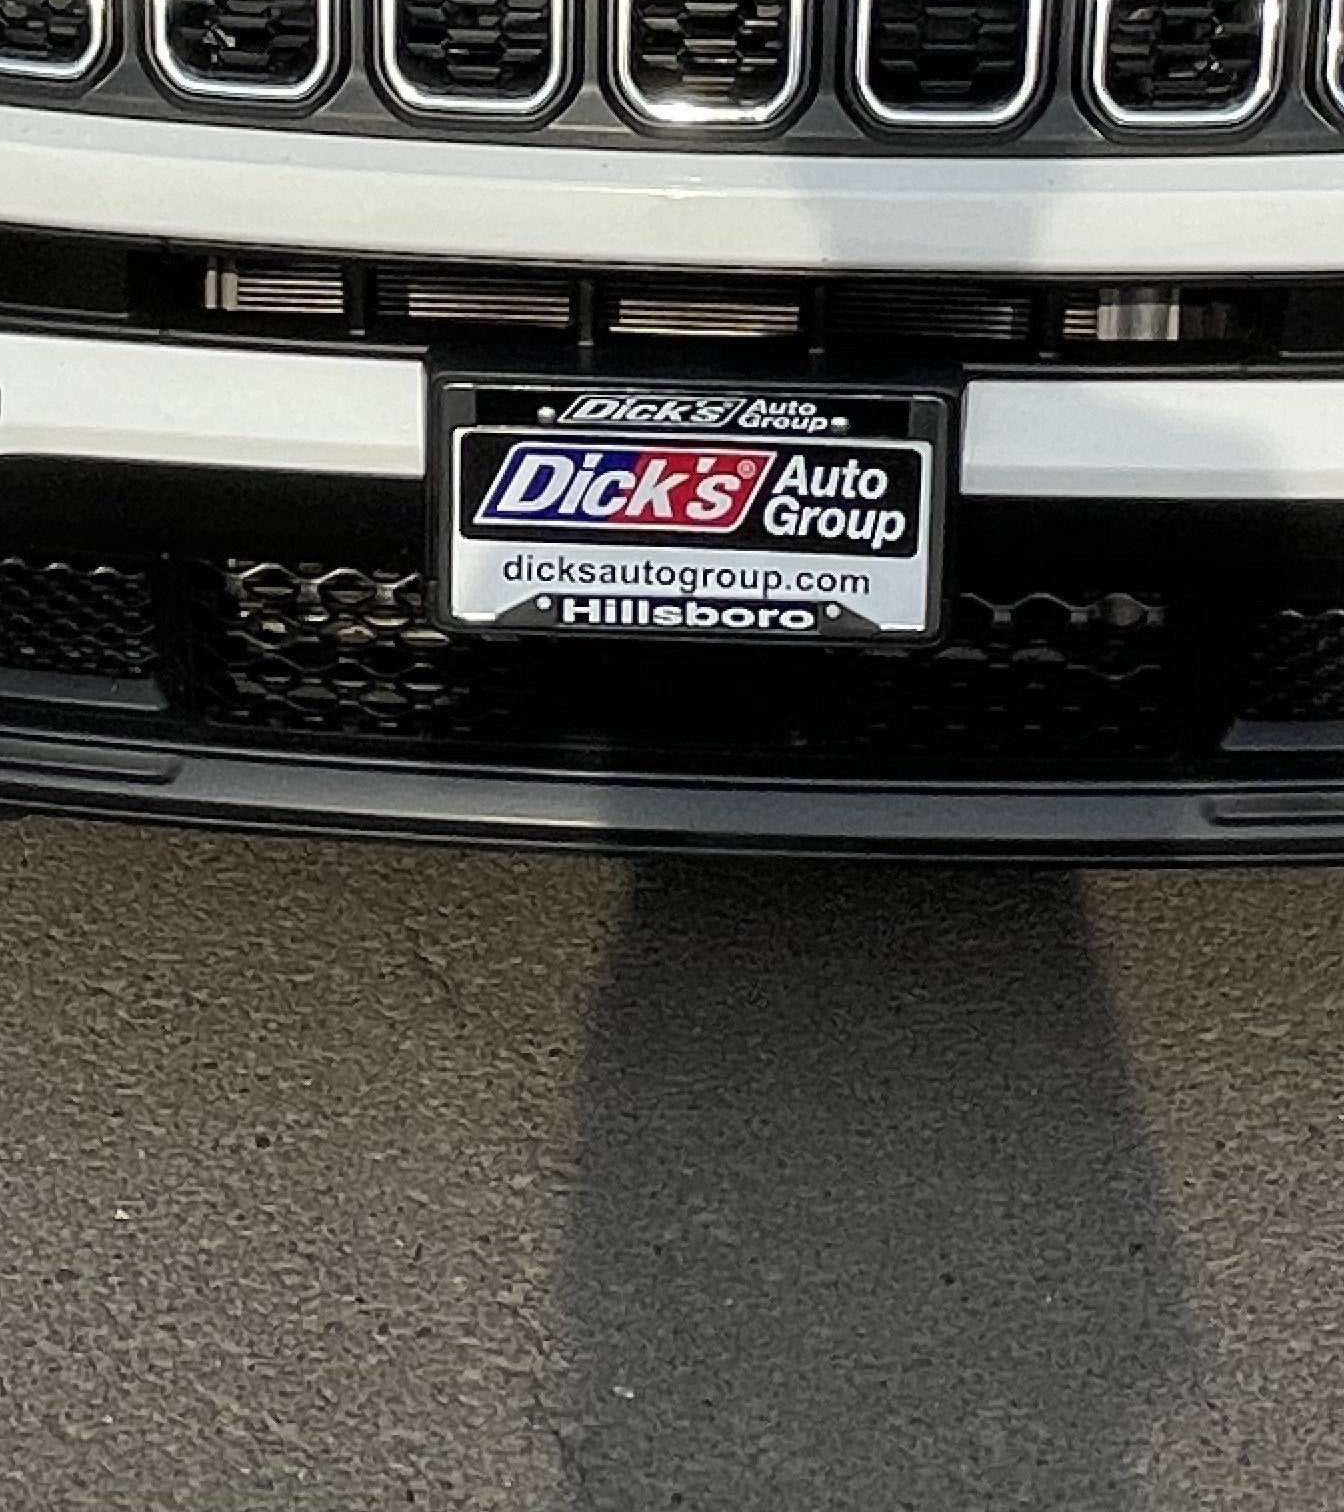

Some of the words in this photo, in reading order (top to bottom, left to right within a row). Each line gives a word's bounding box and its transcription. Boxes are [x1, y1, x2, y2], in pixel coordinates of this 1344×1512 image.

[738, 415, 828, 433] Group
[749, 399, 818, 416] Auto
[497, 452, 742, 521] Dick's
[771, 454, 888, 499] Auto
[763, 494, 906, 550] Group
[504, 555, 870, 599] dicksautogroup.com
[562, 597, 816, 630] Hillsboro
